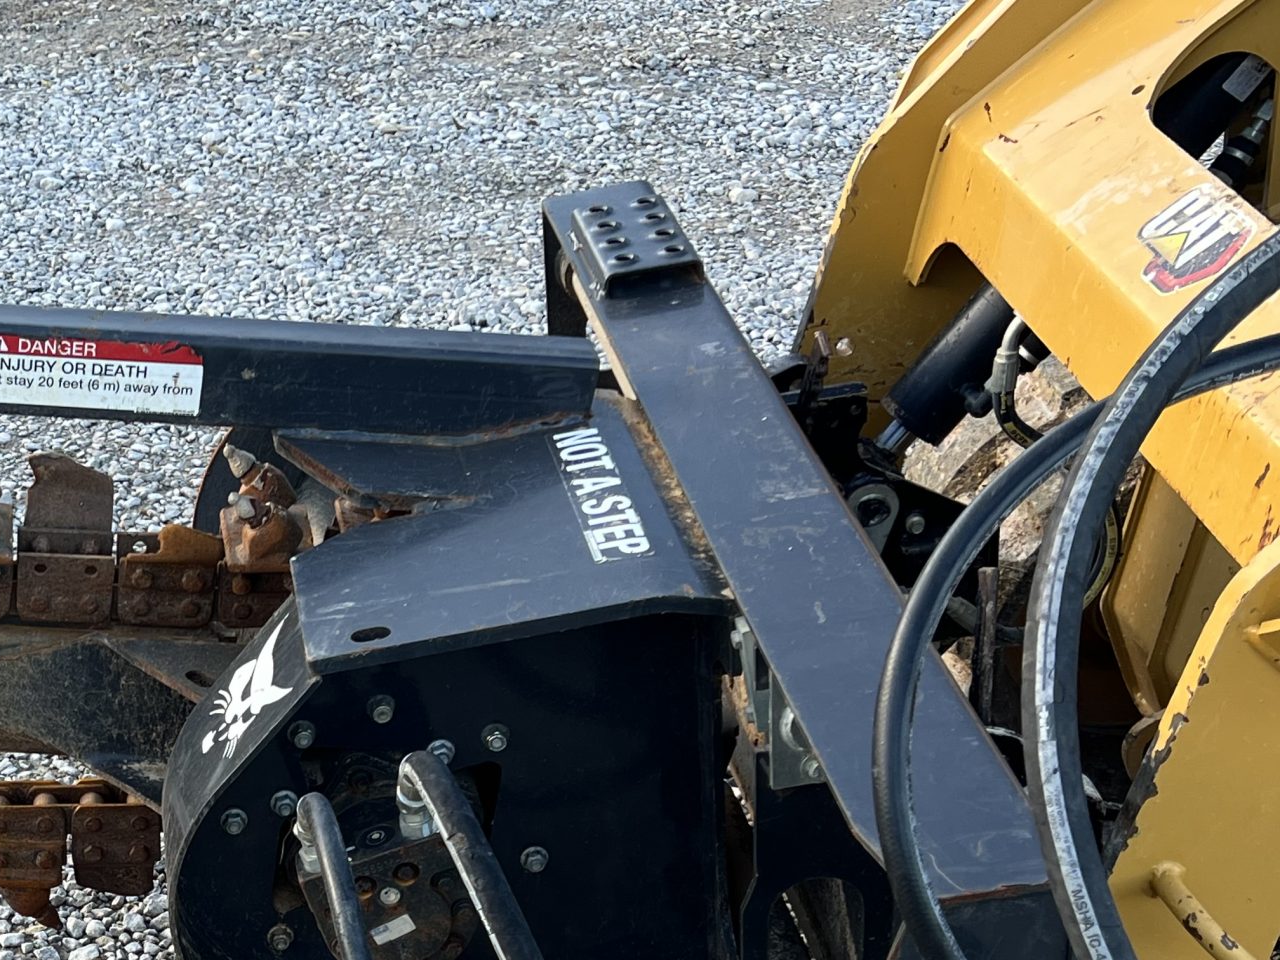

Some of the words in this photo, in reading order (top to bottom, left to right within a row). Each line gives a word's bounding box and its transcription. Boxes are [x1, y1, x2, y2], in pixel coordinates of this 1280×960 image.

[1139, 186, 1242, 270] CAT
[17, 338, 97, 358] DANGER
[6, 376, 34, 389] stay
[37, 377, 54, 388] 20
[58, 377, 84, 390] feet
[87, 378, 100, 392] (6
[103, 380, 121, 394] m)
[123, 384, 159, 397] away
[162, 383, 194, 396] from
[61, 361, 86, 375] OR
[91, 363, 148, 379] DEATH
[553, 427, 616, 473] NOT
[571, 476, 622, 497] A
[581, 494, 651, 555] STEP
[1070, 887, 1096, 932] MSHA
